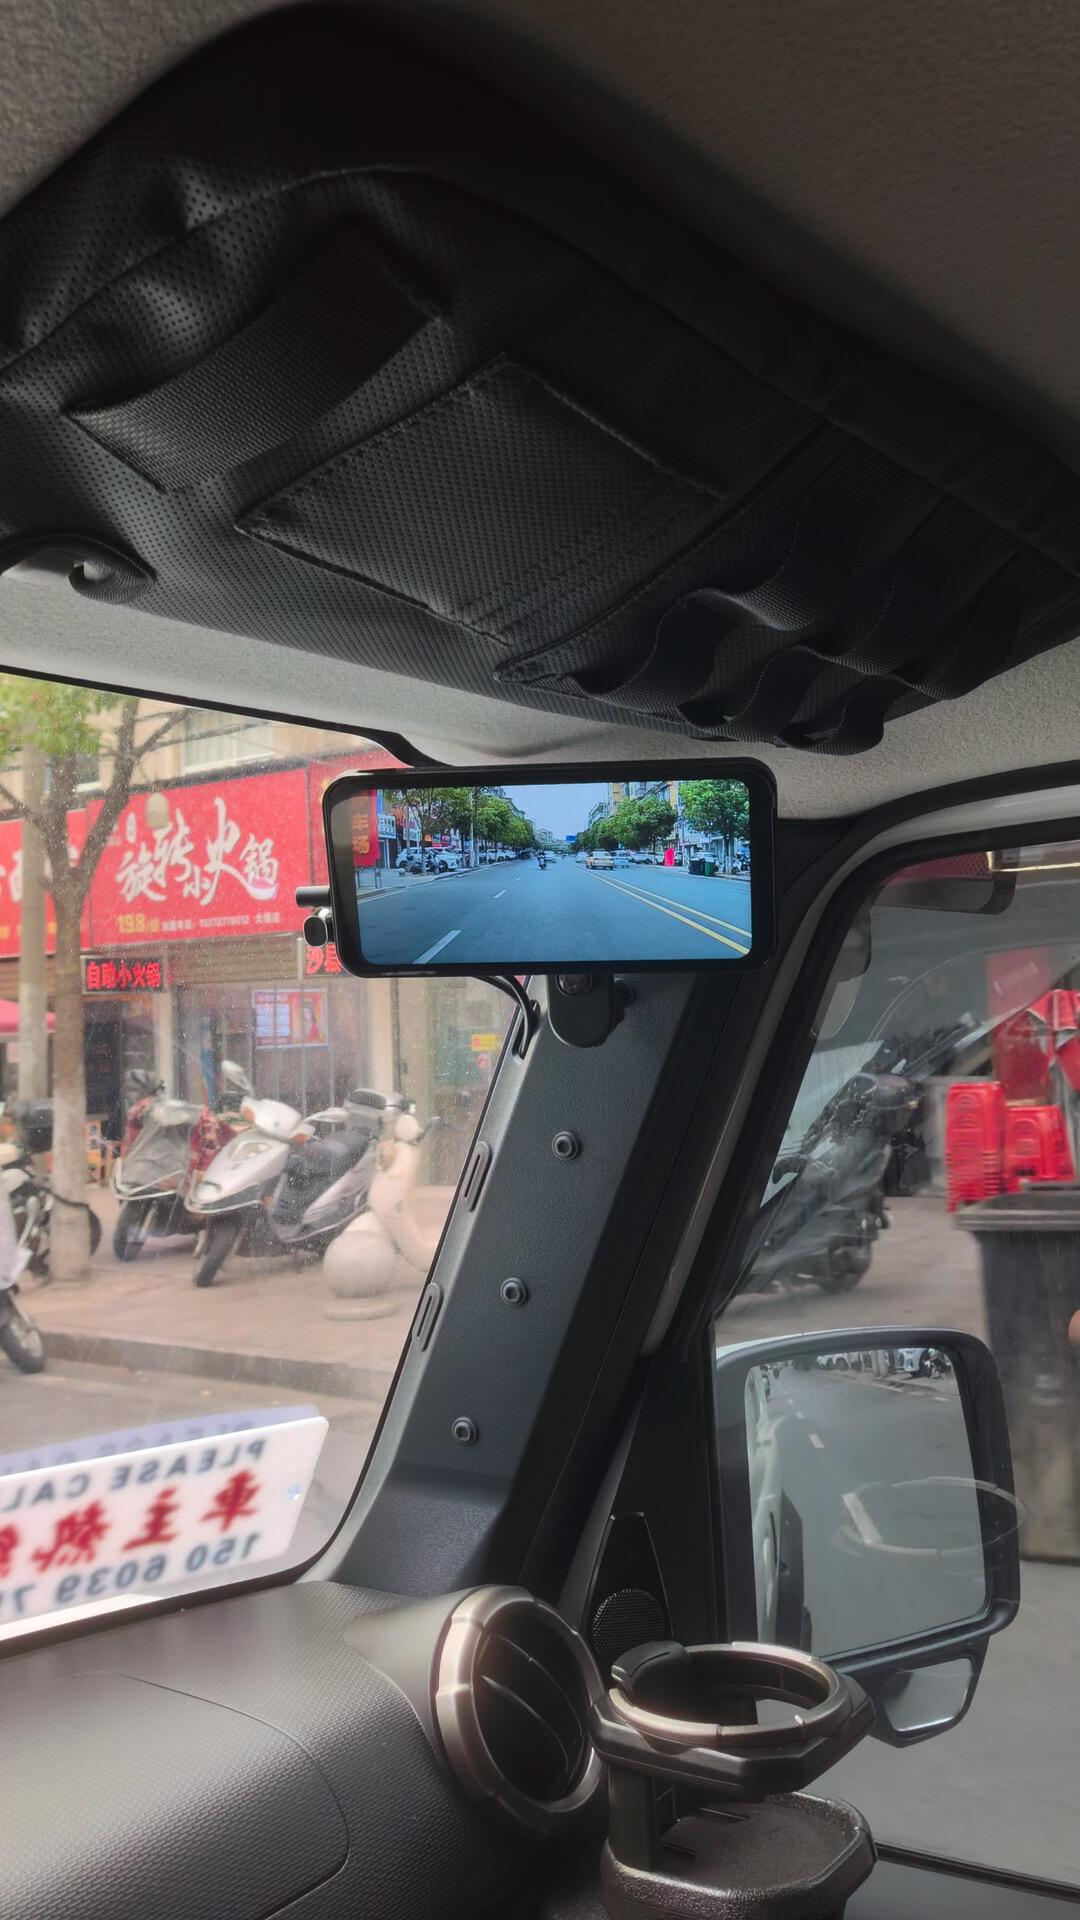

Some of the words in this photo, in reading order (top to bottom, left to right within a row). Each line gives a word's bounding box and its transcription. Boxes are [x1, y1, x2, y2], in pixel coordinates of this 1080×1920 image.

[115, 797, 279, 905] 旋转小火锅
[86, 961, 162, 990] 自助小火锅
